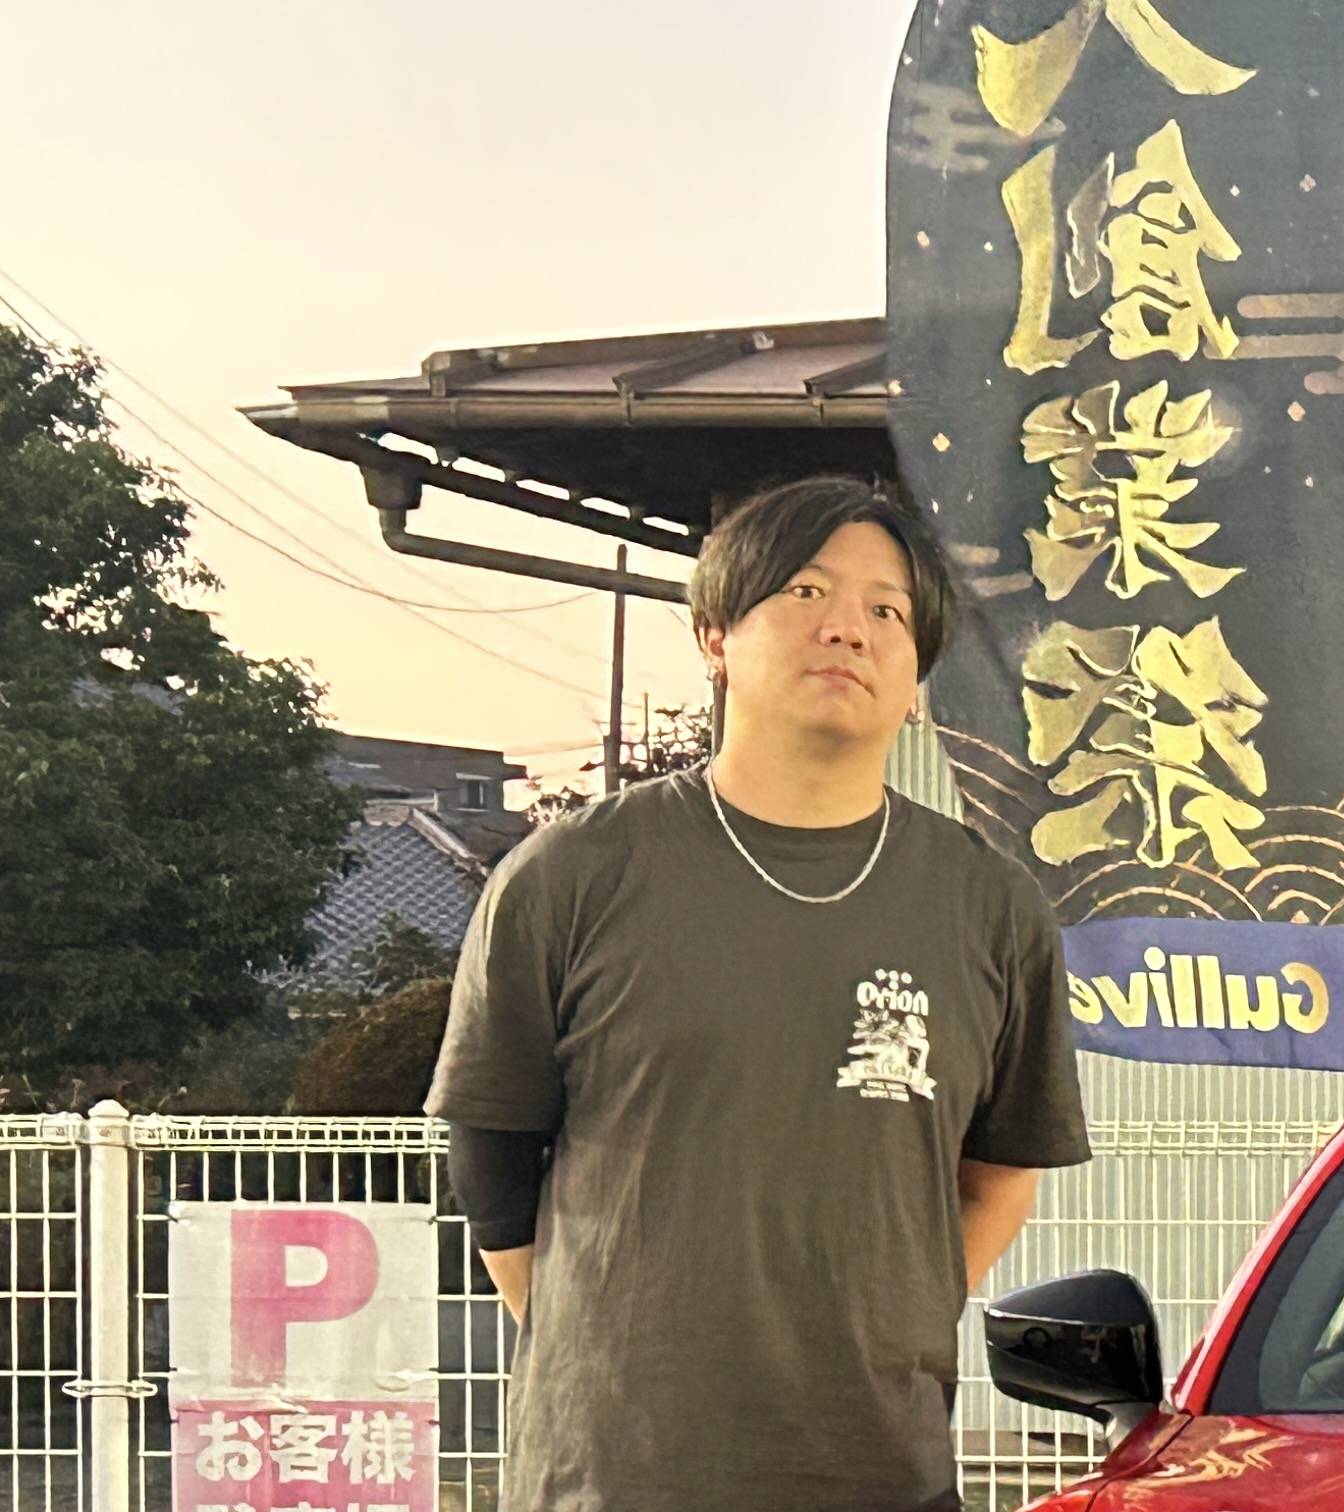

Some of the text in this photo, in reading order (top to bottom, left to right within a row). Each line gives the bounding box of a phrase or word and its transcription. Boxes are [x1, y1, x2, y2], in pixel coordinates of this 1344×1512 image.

[857, 980, 929, 1017] Orion
[230, 1209, 380, 1388] P
[196, 1410, 415, 1484] お客様
